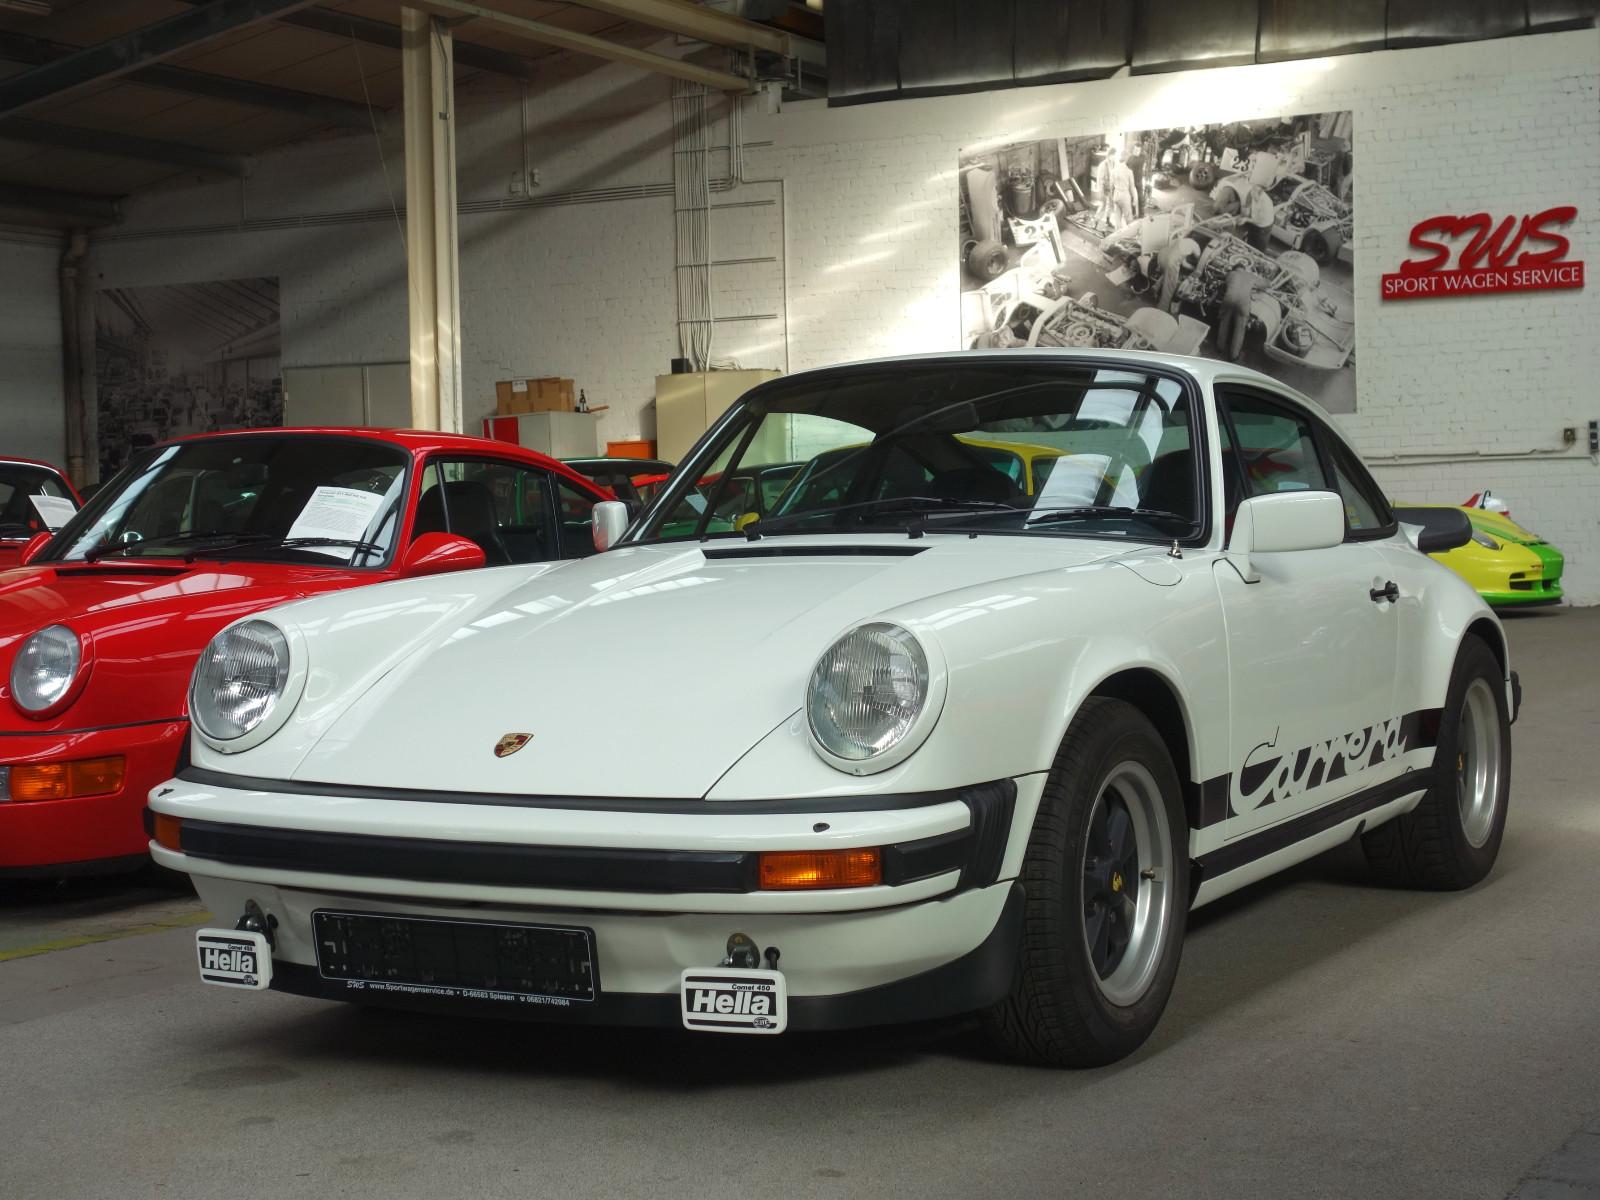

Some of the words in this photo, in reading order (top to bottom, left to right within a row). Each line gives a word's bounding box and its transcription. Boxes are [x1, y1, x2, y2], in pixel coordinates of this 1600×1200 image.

[1399, 206, 1578, 275] SWS
[1385, 276, 1439, 294] SPORT
[1444, 271, 1509, 290] WAGEN
[1513, 266, 1581, 286] SERVICE
[1230, 722, 1408, 814] Carrera
[205, 948, 254, 973] Hella
[731, 983, 755, 991] Comet
[692, 989, 770, 1015] Hella
